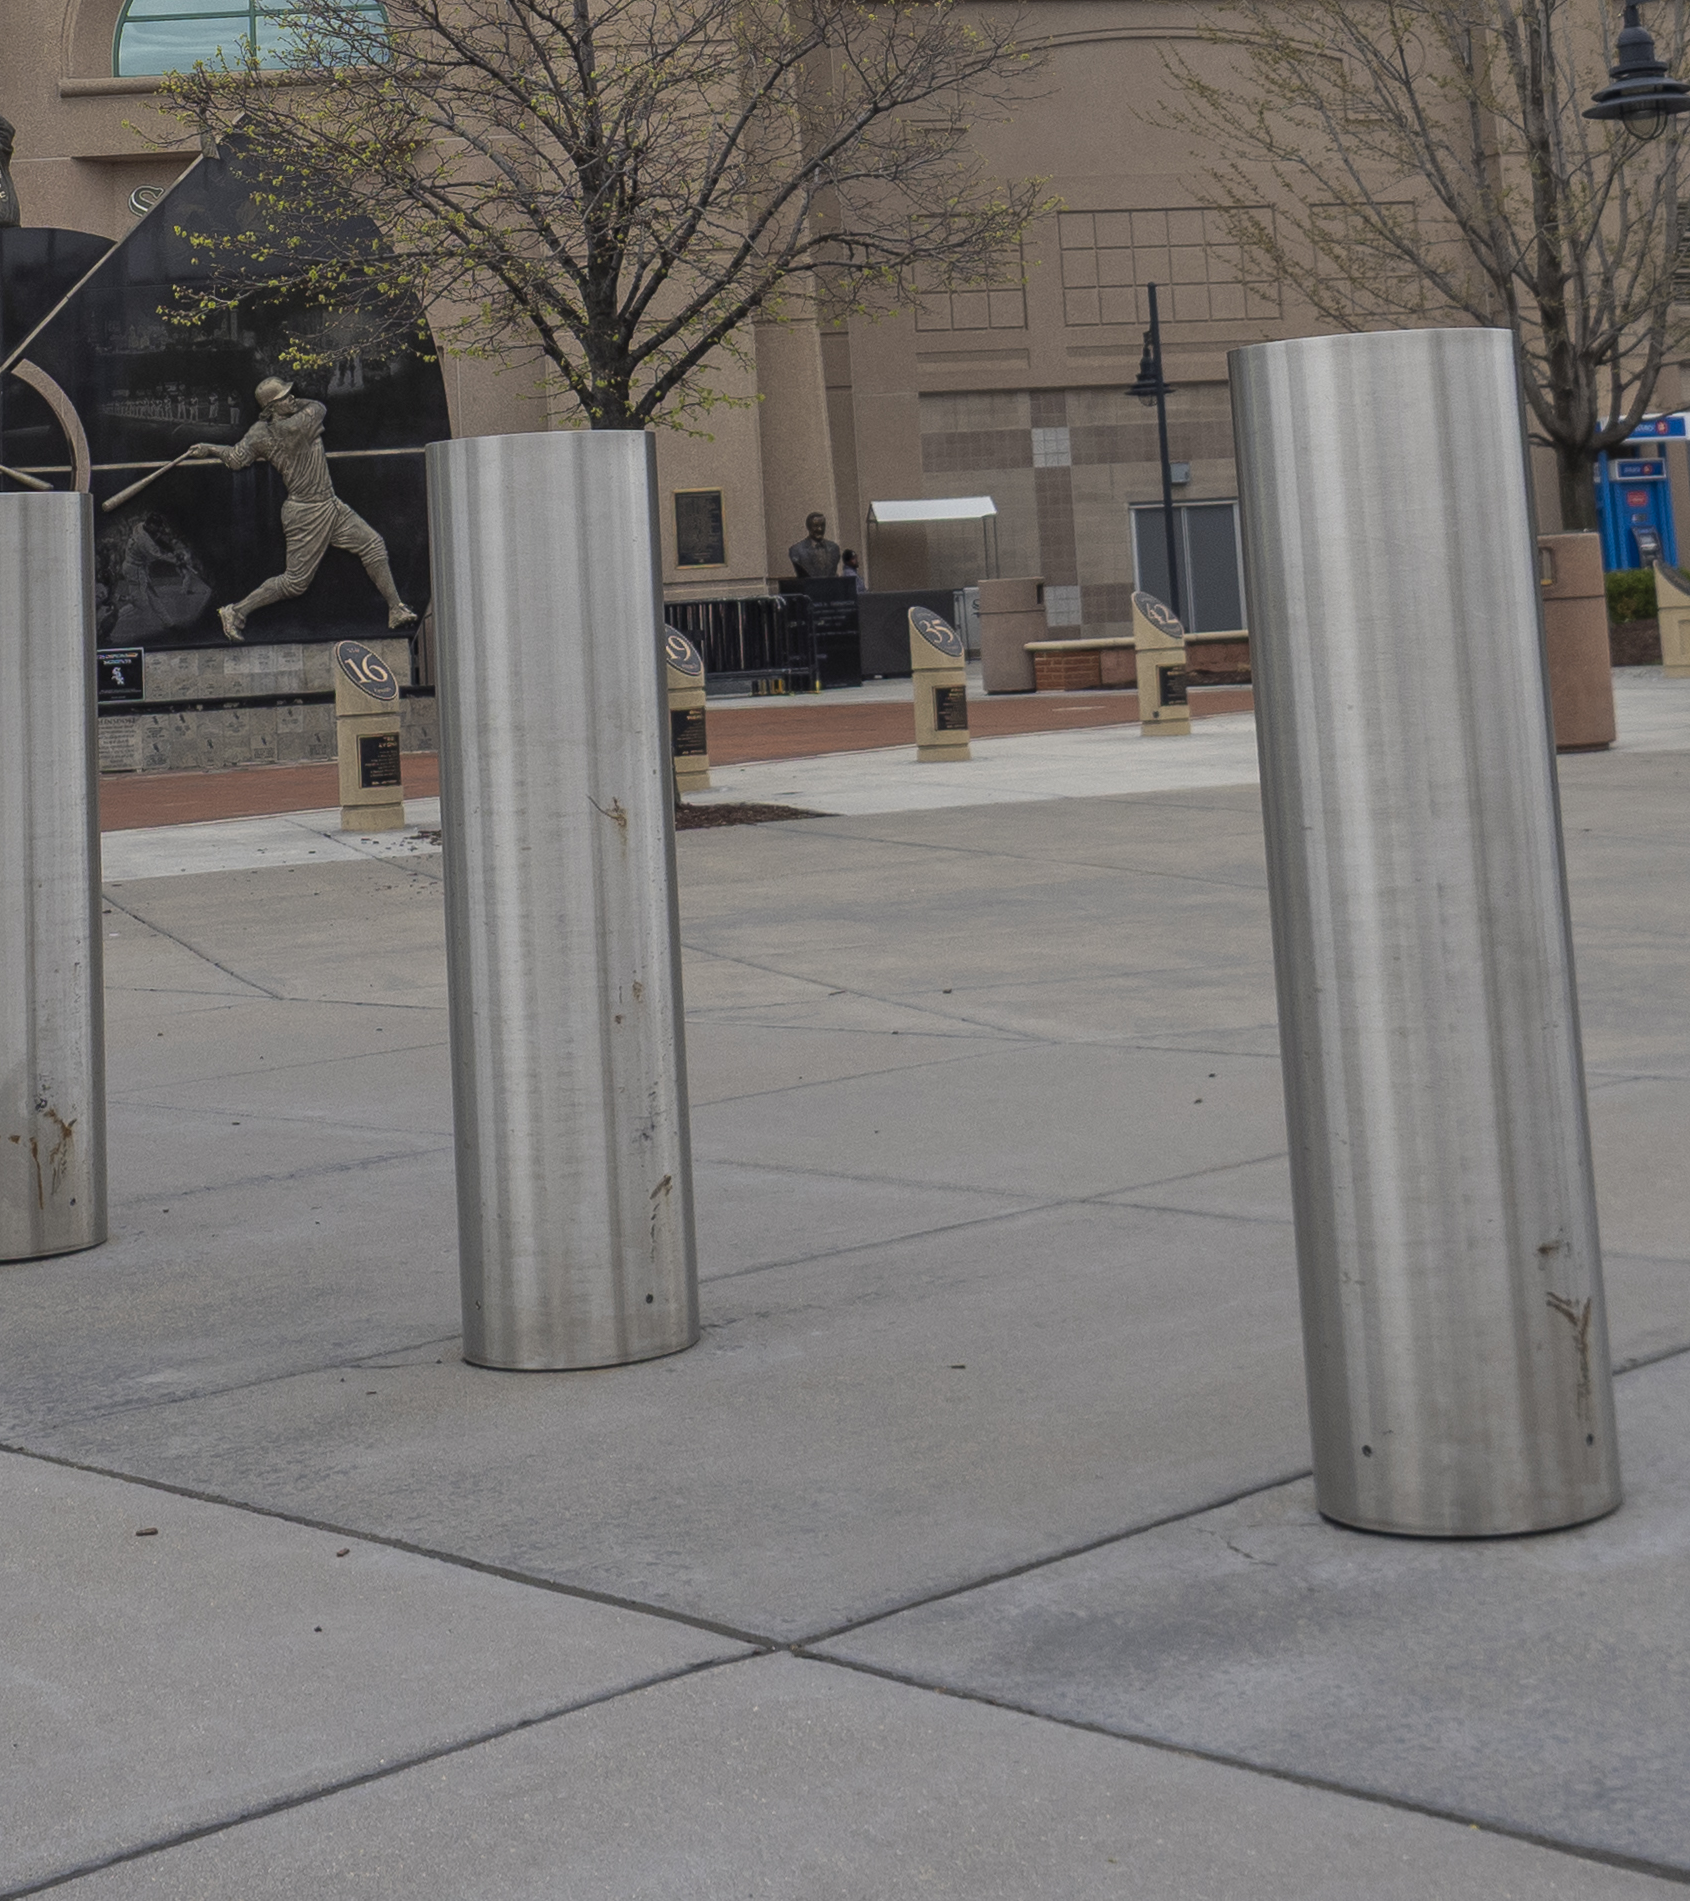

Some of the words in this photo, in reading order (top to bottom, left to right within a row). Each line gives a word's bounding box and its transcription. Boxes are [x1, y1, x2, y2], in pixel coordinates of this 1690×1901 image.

[1146, 602, 1179, 625] 42
[918, 619, 954, 644] 35
[344, 652, 388, 684] 16
